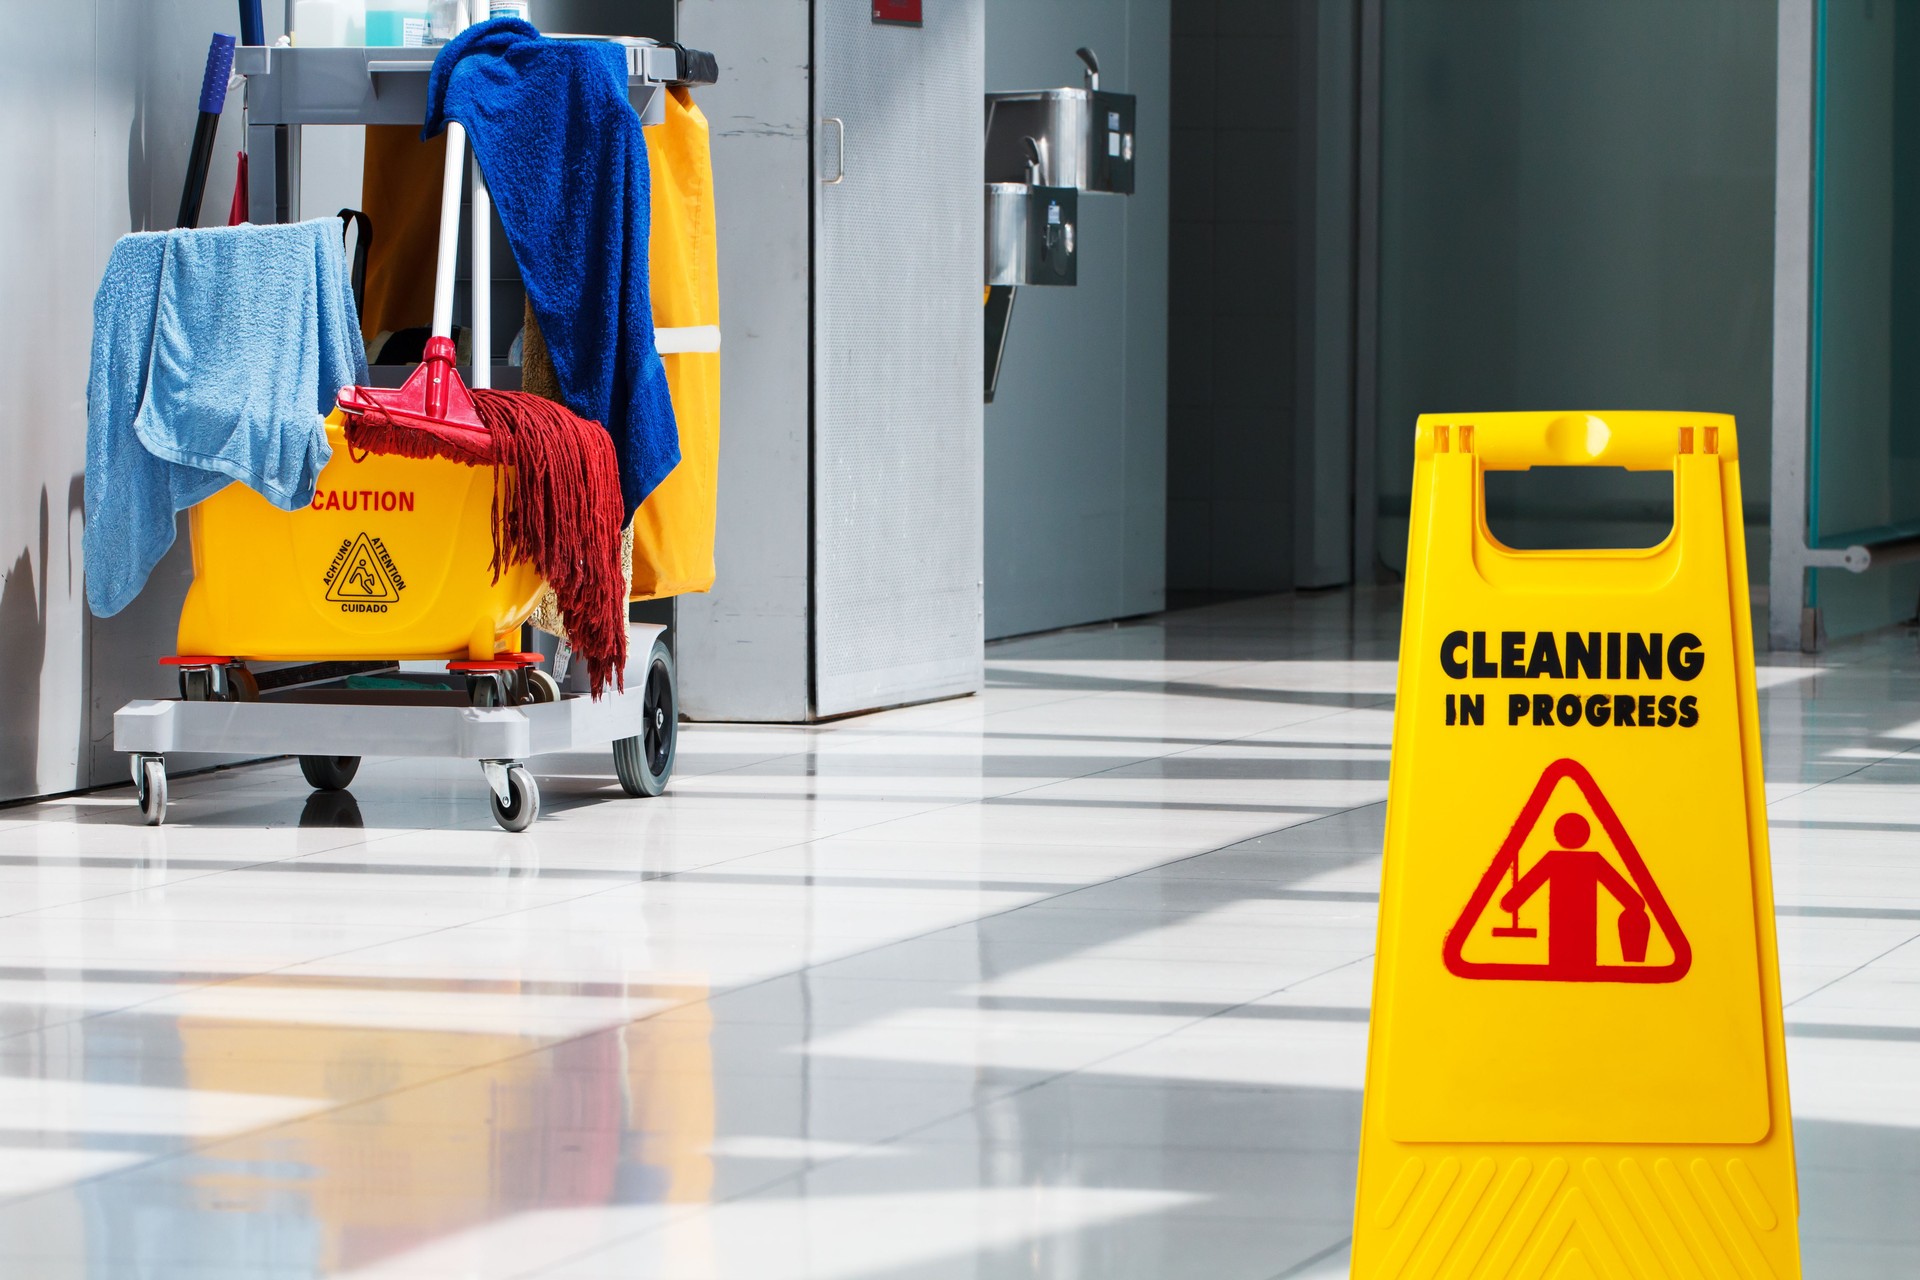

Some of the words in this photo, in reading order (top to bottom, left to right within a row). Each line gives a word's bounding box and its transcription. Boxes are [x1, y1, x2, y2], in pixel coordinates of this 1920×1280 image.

[311, 490, 415, 512] CAUTION
[323, 539, 352, 586] ACHTUNG
[371, 537, 406, 591] ATTENTION
[341, 603, 388, 613] CUIDADO
[1440, 630, 1705, 681] CLEANING
[1445, 694, 1485, 726] IN
[1508, 693, 1700, 728] PROGRESS
